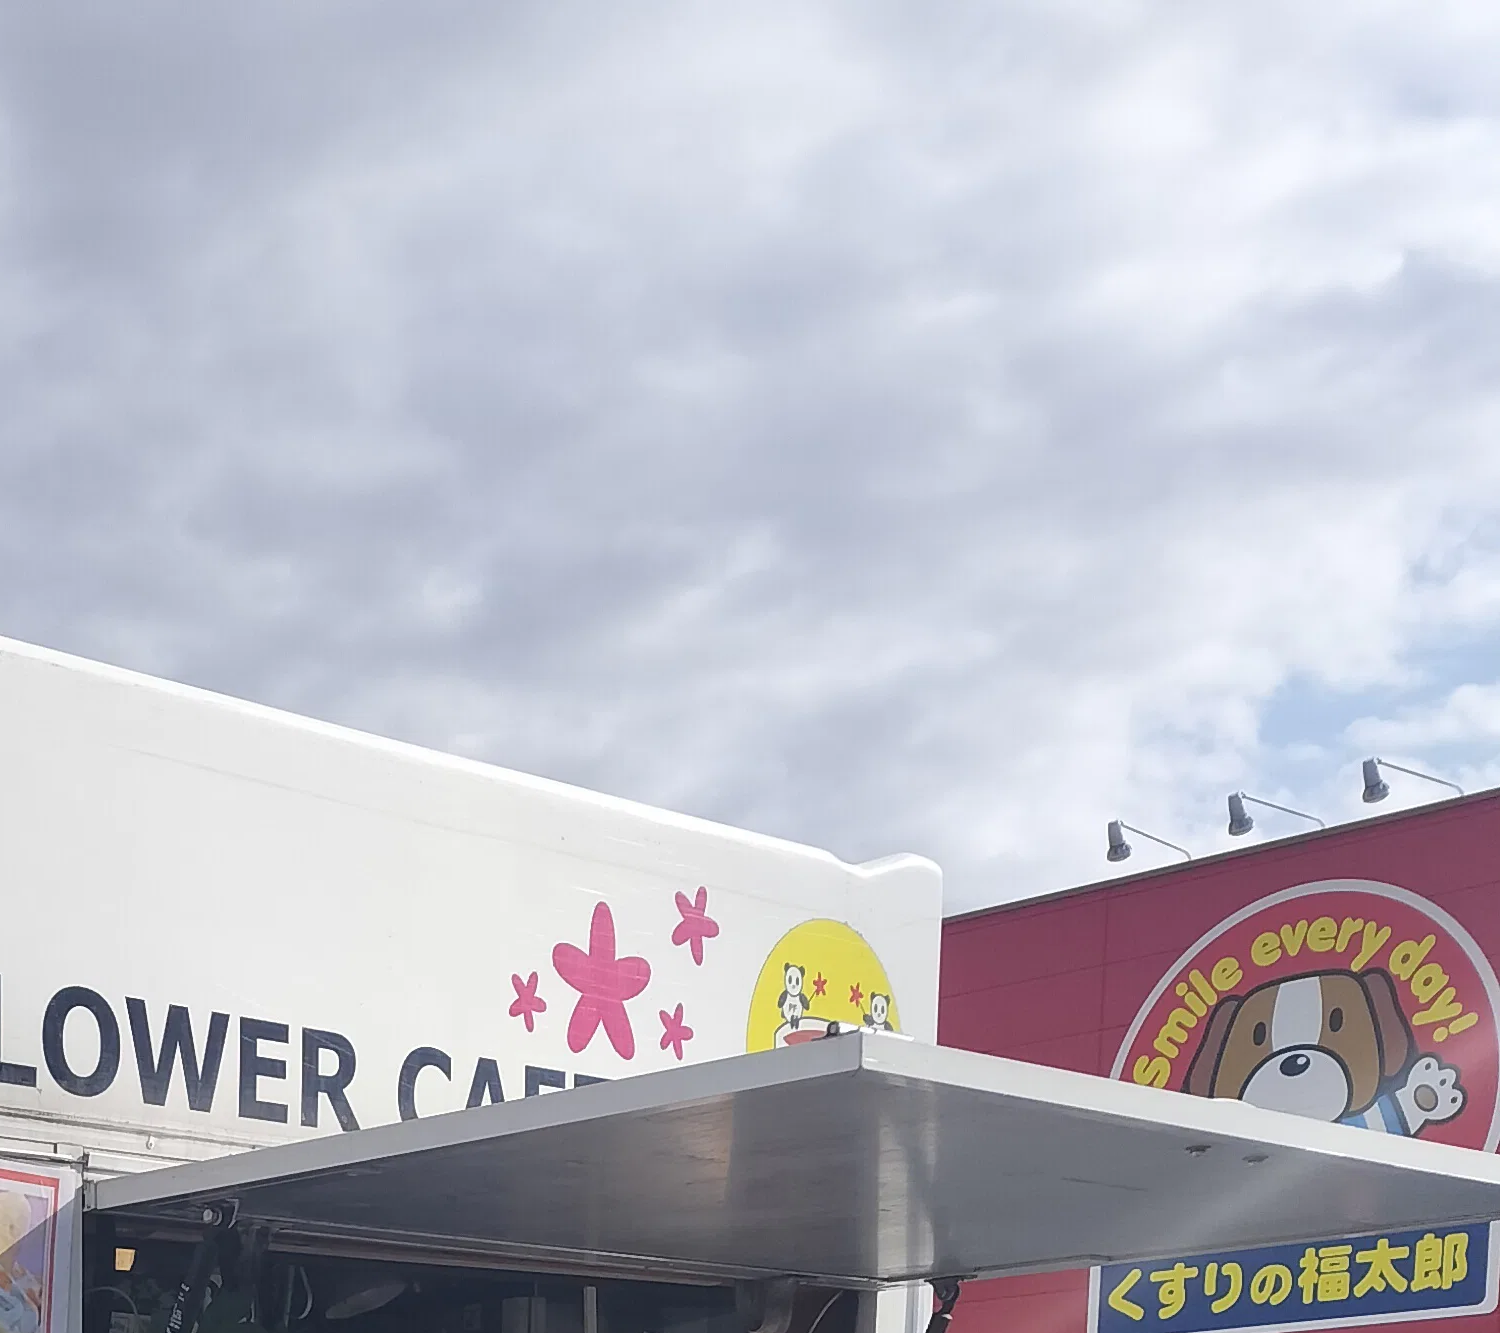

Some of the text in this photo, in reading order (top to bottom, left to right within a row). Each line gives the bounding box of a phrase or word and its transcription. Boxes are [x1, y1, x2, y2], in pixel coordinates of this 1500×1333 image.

[1132, 916, 1480, 1089] Smile every day!
[398, 1046, 613, 1122] CA
[1106, 1231, 1469, 1322] くすりの福太郎
